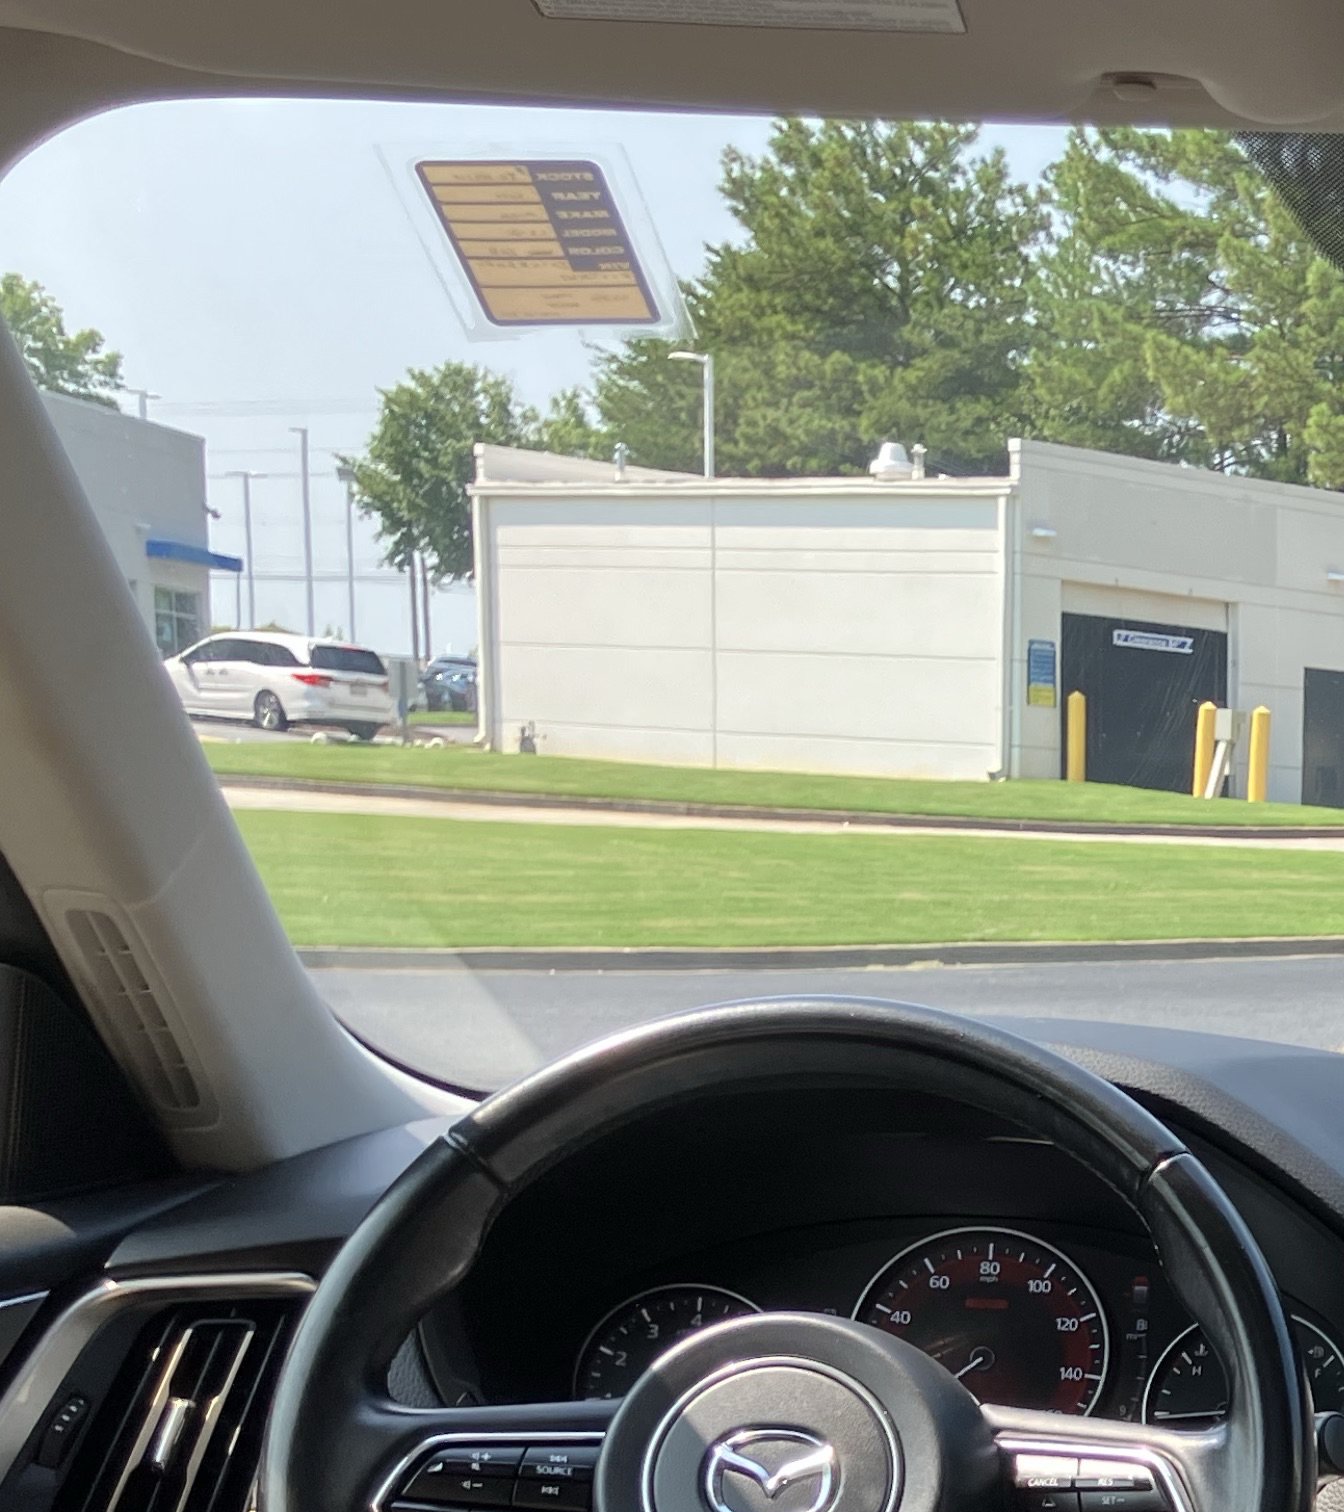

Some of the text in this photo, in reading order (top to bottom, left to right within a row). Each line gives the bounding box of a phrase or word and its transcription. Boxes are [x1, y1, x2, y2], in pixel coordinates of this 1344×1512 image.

[980, 1262, 1000, 1275] 80
[929, 1275, 949, 1290] 60
[1027, 1279, 1051, 1294] 100
[890, 1312, 911, 1325] 40
[1055, 1317, 1078, 1332] 120
[647, 1324, 659, 1339] 3
[615, 1351, 627, 1366] 2
[1059, 1366, 1083, 1381] 140
[536, 1465, 573, 1477] SOURCE
[1027, 1478, 1059, 1487] CANCEL
